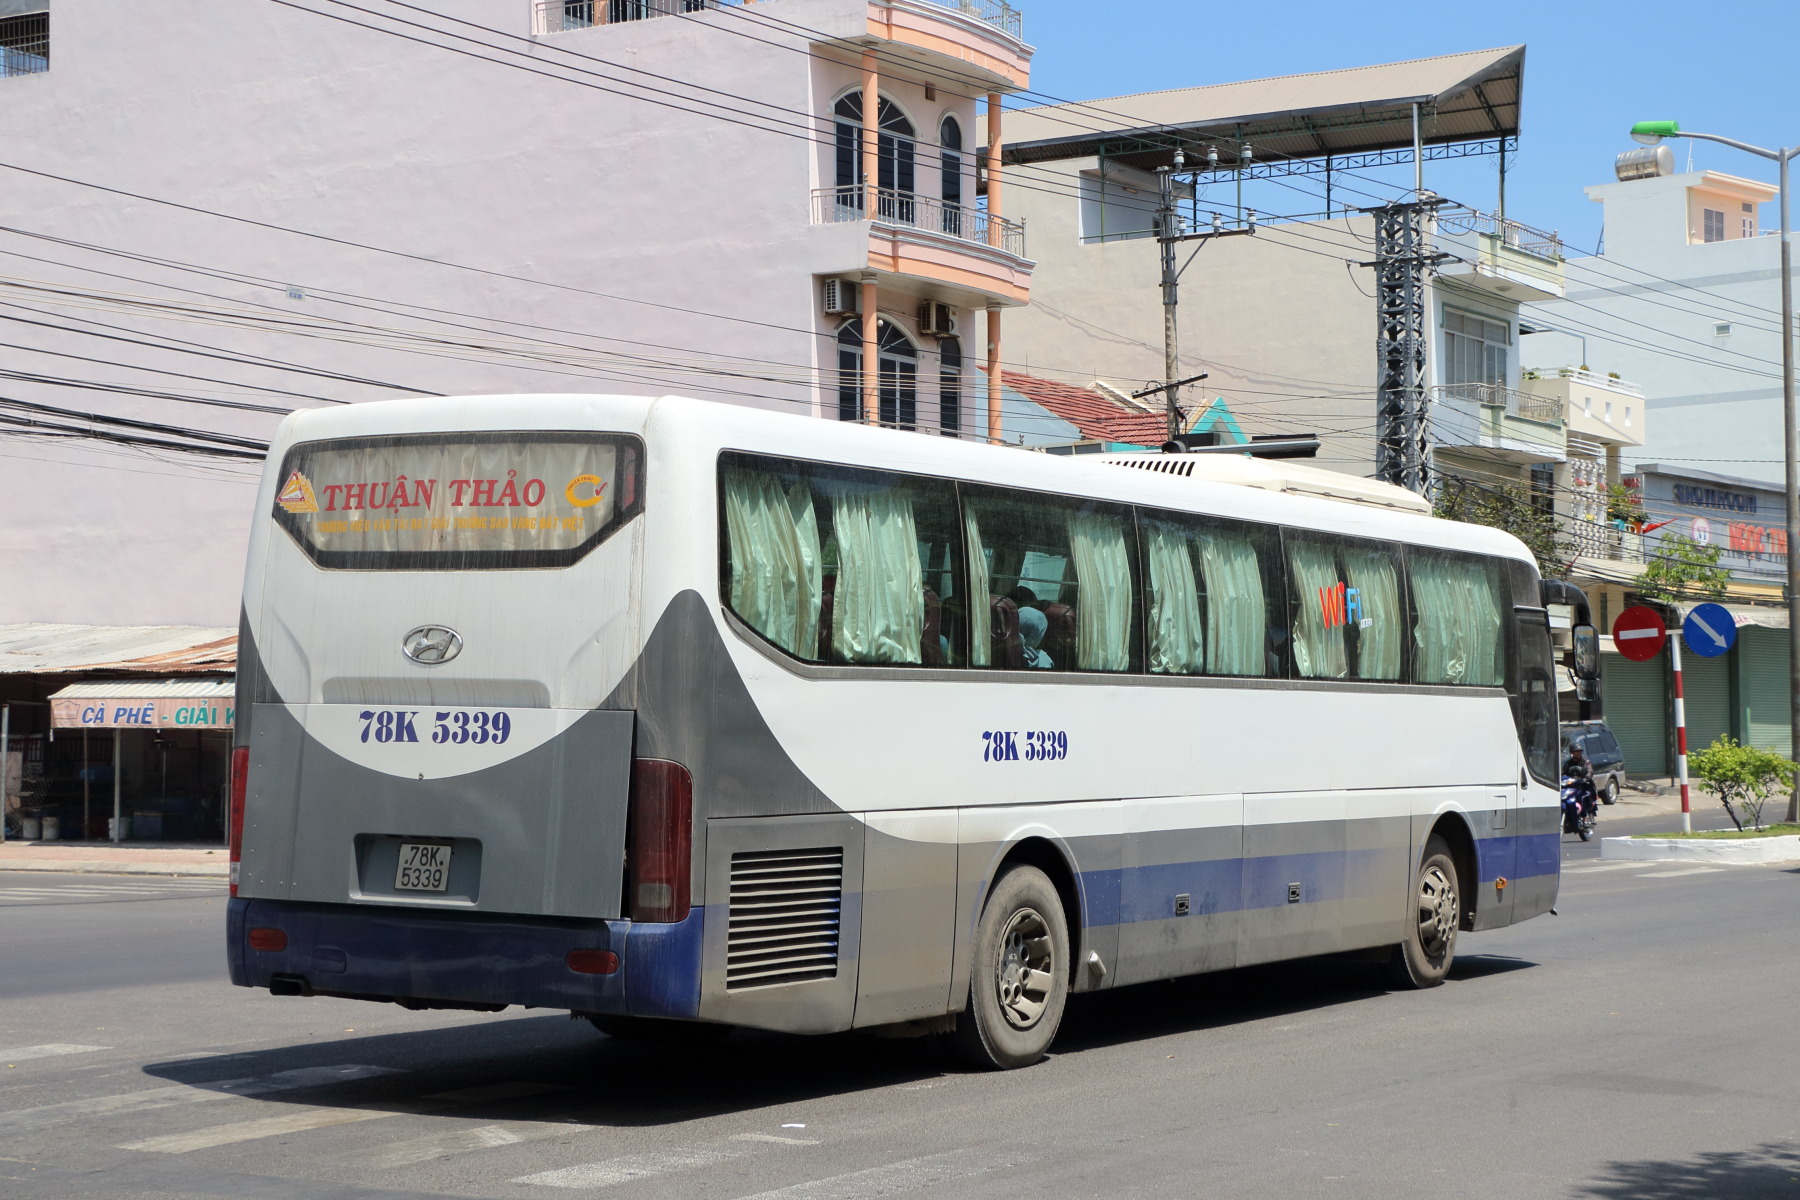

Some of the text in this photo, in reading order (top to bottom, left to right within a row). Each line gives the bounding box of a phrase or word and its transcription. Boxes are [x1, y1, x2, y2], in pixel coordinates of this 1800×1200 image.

[322, 469, 546, 514] THUẬN THẢO
[489, 517, 508, 529] SAO
[82, 702, 105, 724] CÀ
[113, 702, 155, 724] PHÊ
[175, 700, 217, 725] GIẢI
[359, 710, 512, 744] 78K 5339
[982, 730, 1068, 762] 78K 5339
[401, 867, 443, 888] 5339
